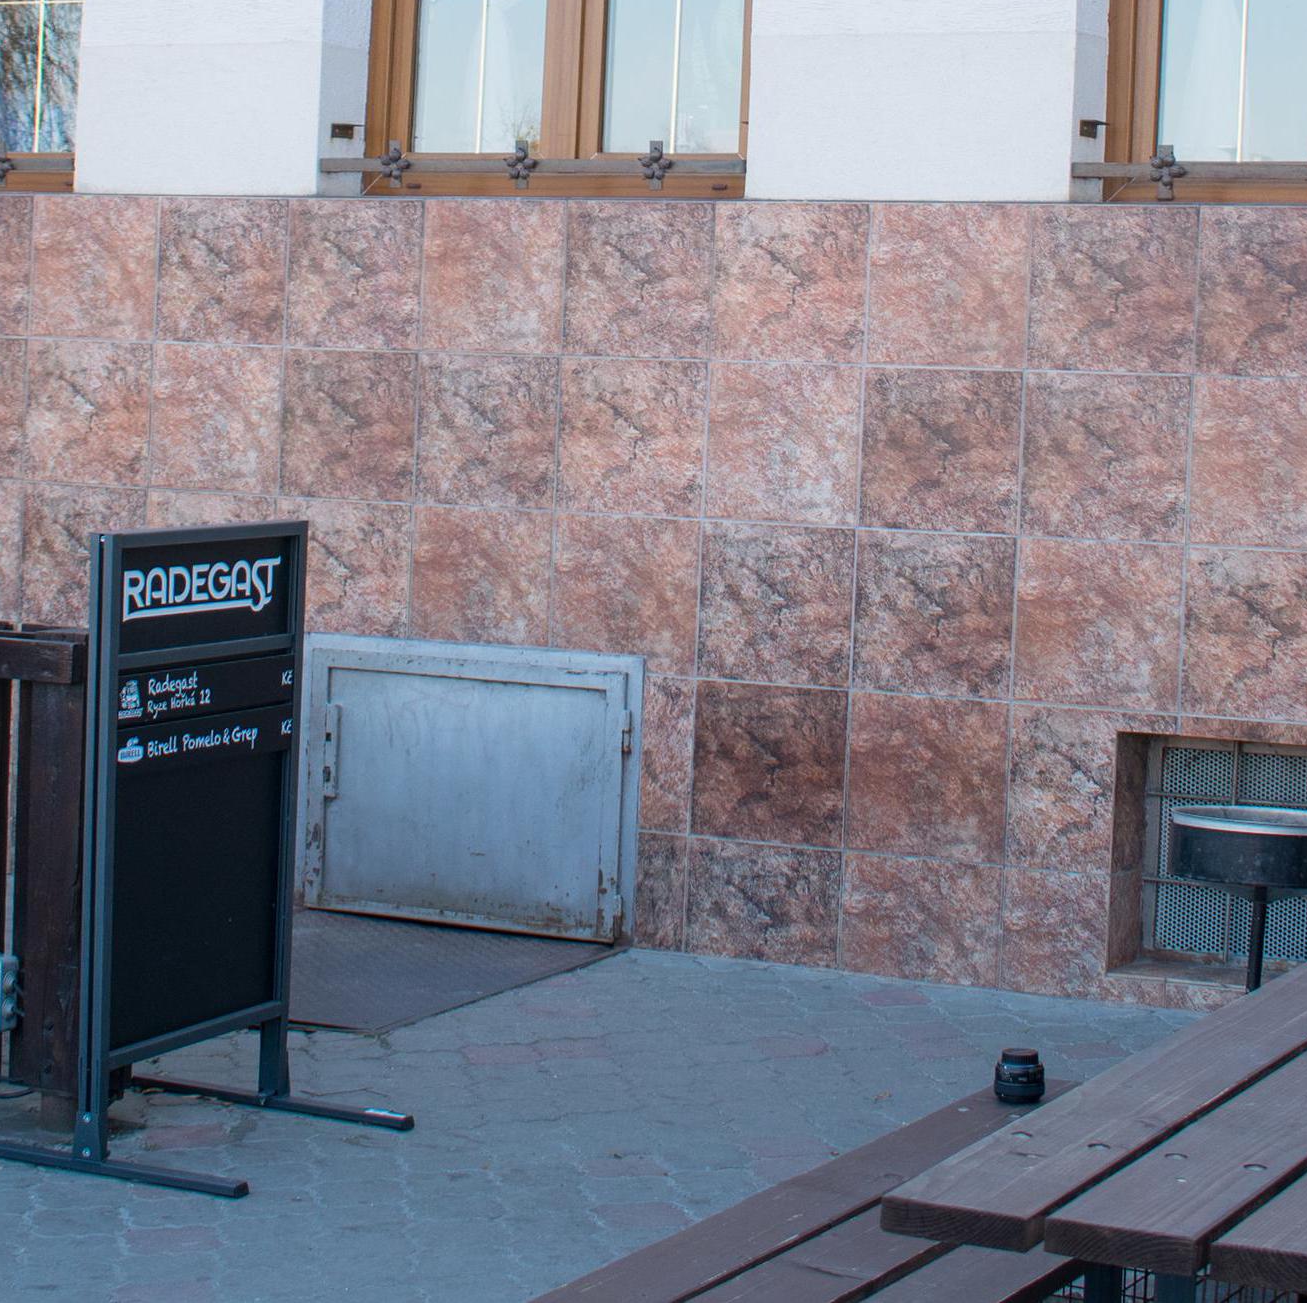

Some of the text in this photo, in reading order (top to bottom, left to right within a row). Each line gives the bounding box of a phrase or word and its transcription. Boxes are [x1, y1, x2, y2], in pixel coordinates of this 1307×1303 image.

[122, 555, 282, 622] RADEGAST
[148, 671, 199, 697] Radegast
[281, 670, 293, 685] Kč
[170, 692, 196, 709] Hořká
[199, 688, 211, 705] 12
[280, 718, 293, 734] Kč
[147, 727, 259, 758] Birell Pomelo & Grep
